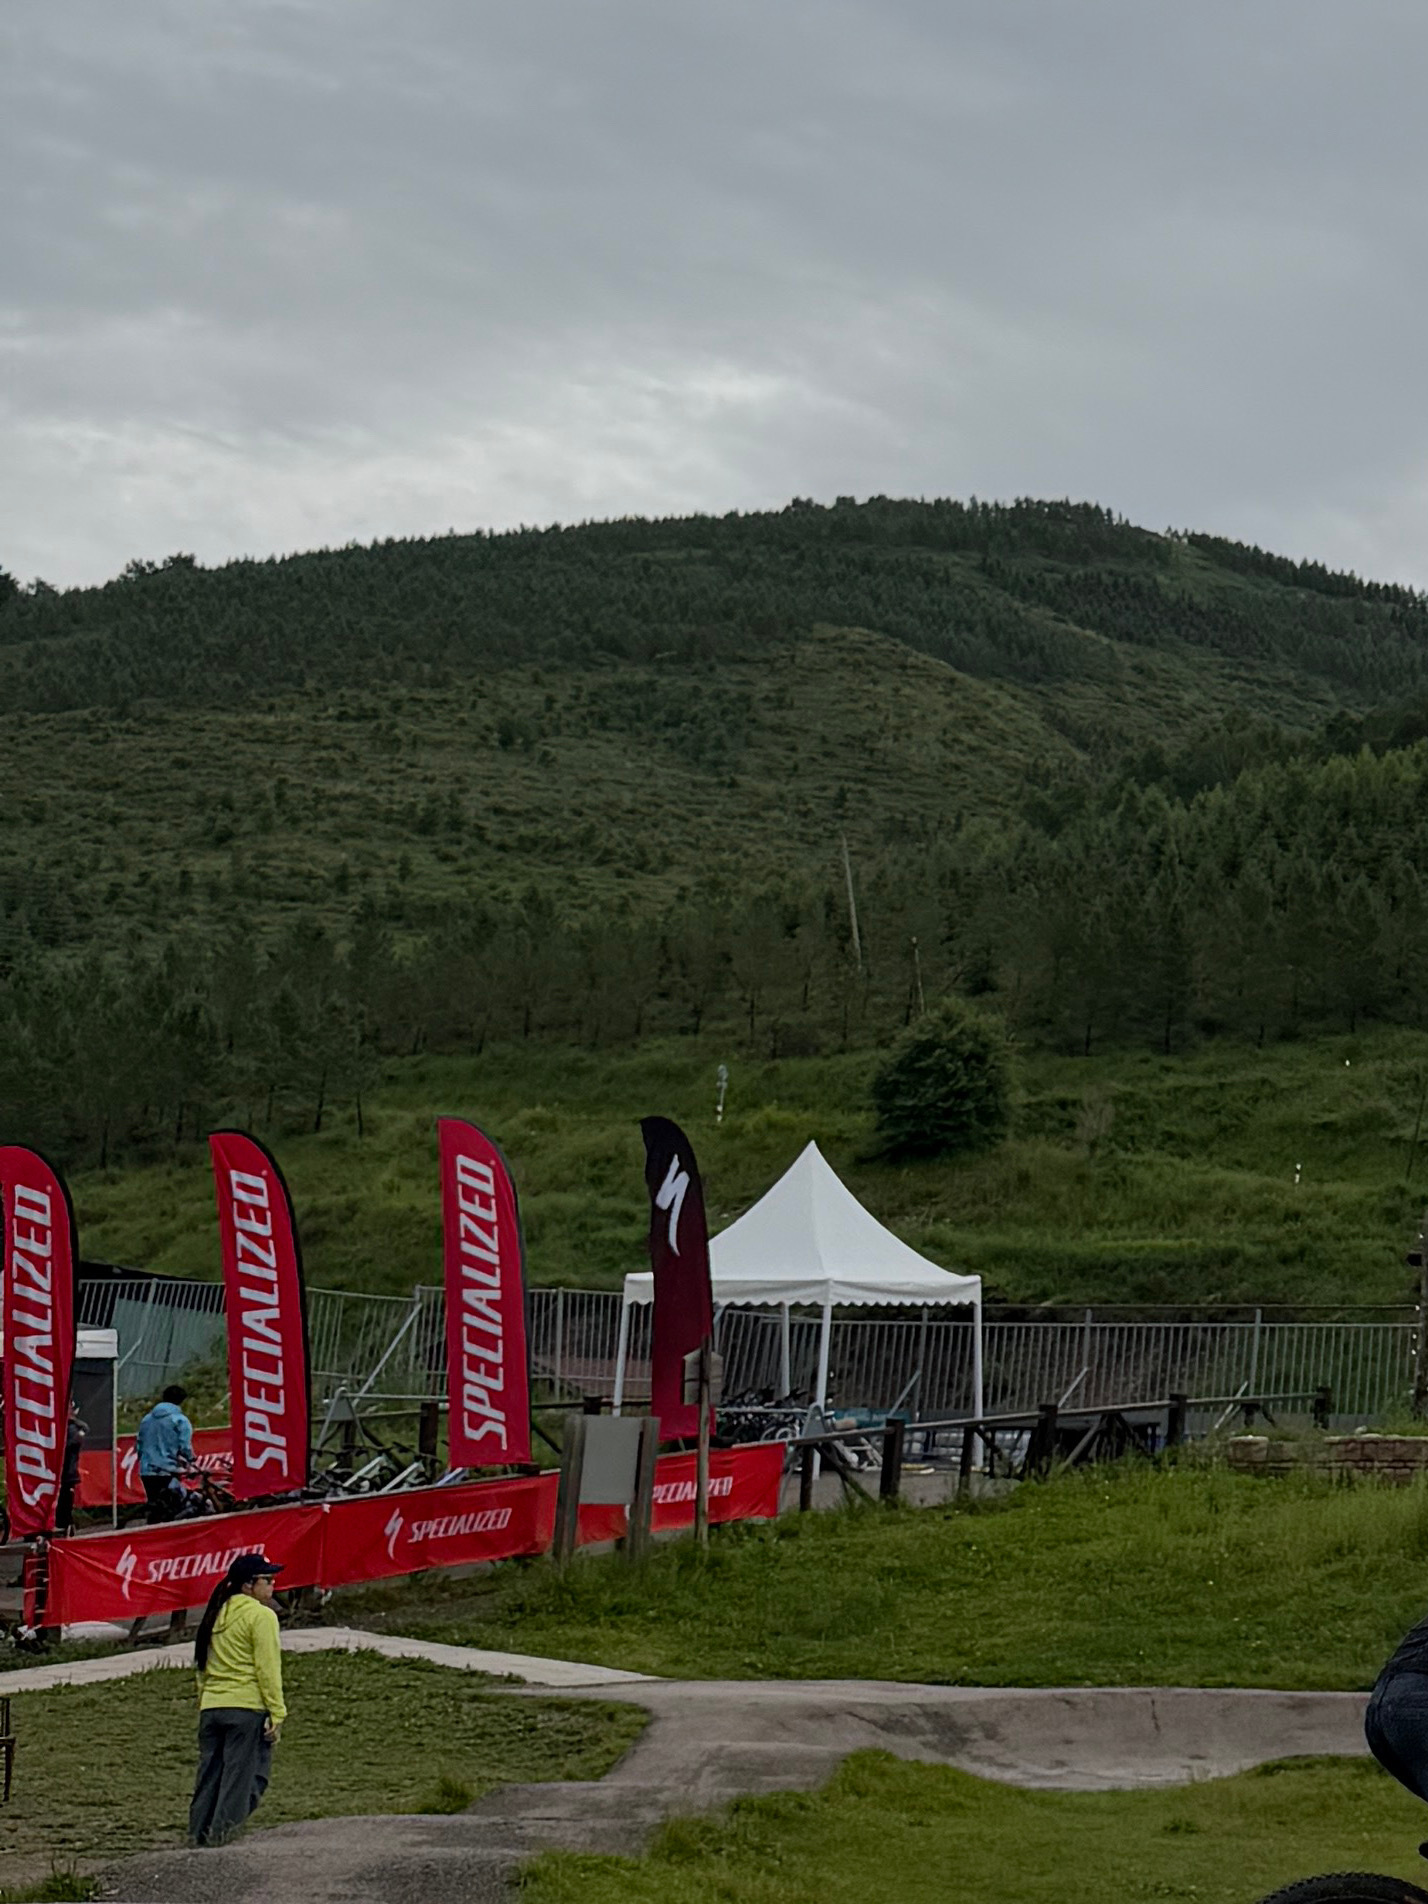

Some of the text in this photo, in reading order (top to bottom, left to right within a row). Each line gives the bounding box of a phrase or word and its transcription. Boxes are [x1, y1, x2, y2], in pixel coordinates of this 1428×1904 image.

[12, 1184, 56, 1505] SPECIALIZED
[230, 1169, 288, 1477] SPECIALIZED
[456, 1153, 507, 1450] SPECIALIZED
[407, 1508, 512, 1543] SPECIALIZED
